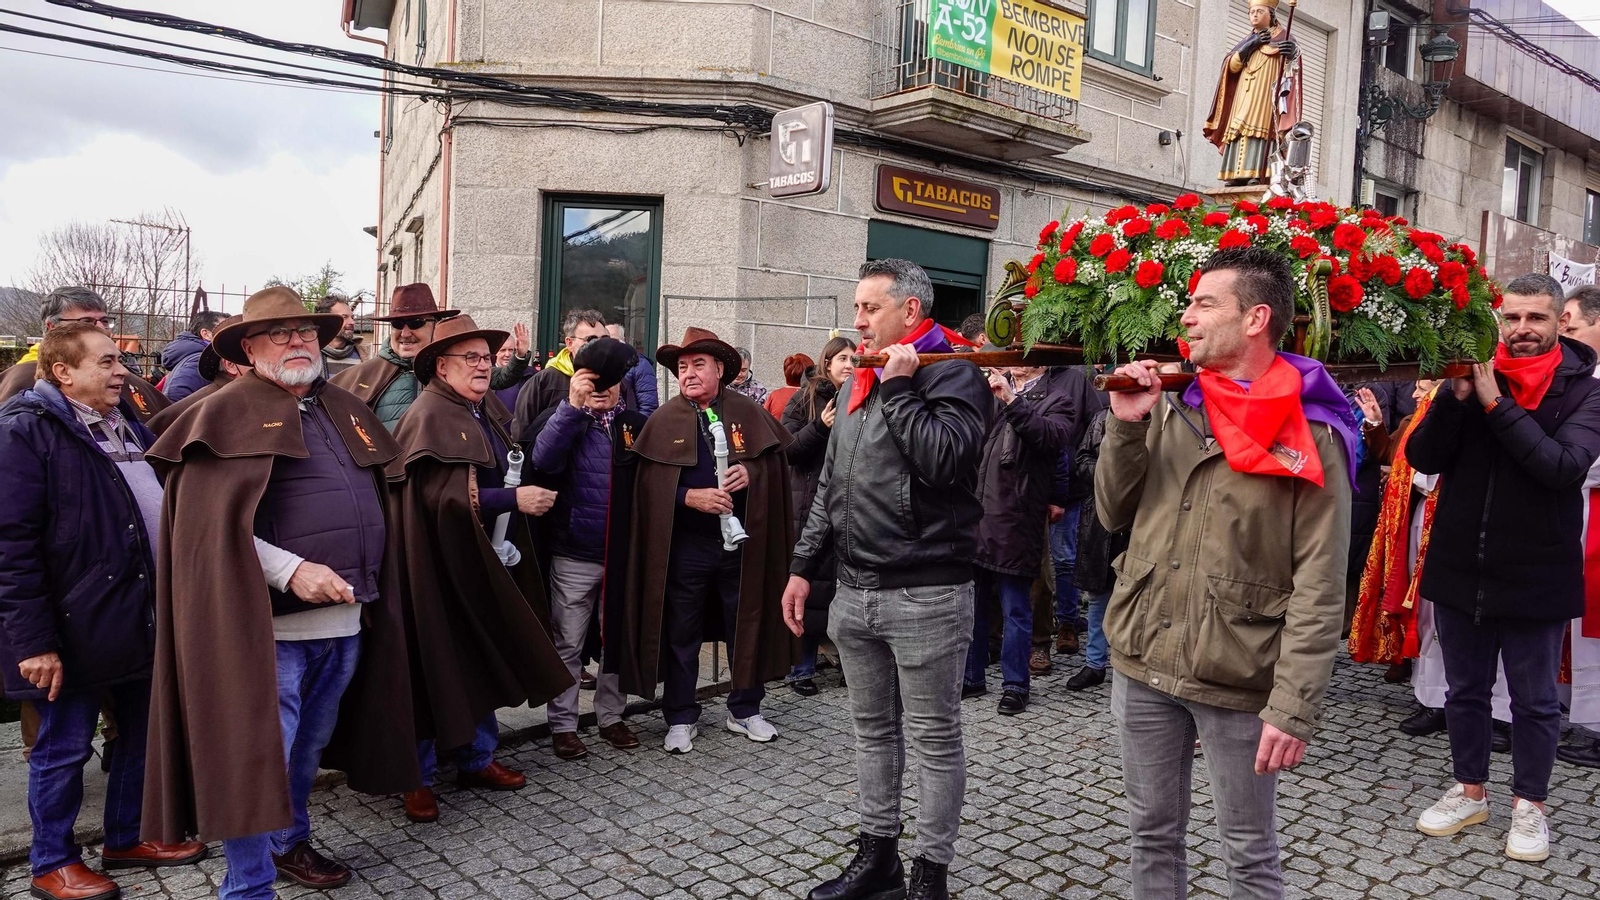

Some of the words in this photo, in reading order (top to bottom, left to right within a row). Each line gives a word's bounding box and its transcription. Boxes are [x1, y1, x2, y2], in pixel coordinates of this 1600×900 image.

[934, 4, 986, 45] A-52
[1001, 1, 1084, 46] BEMBRIVE
[1007, 27, 1054, 62] NON
[1055, 45, 1075, 69] SE
[1010, 54, 1072, 92] ROMPE
[769, 171, 815, 189] TABACOS
[913, 180, 992, 210] TABACOS
